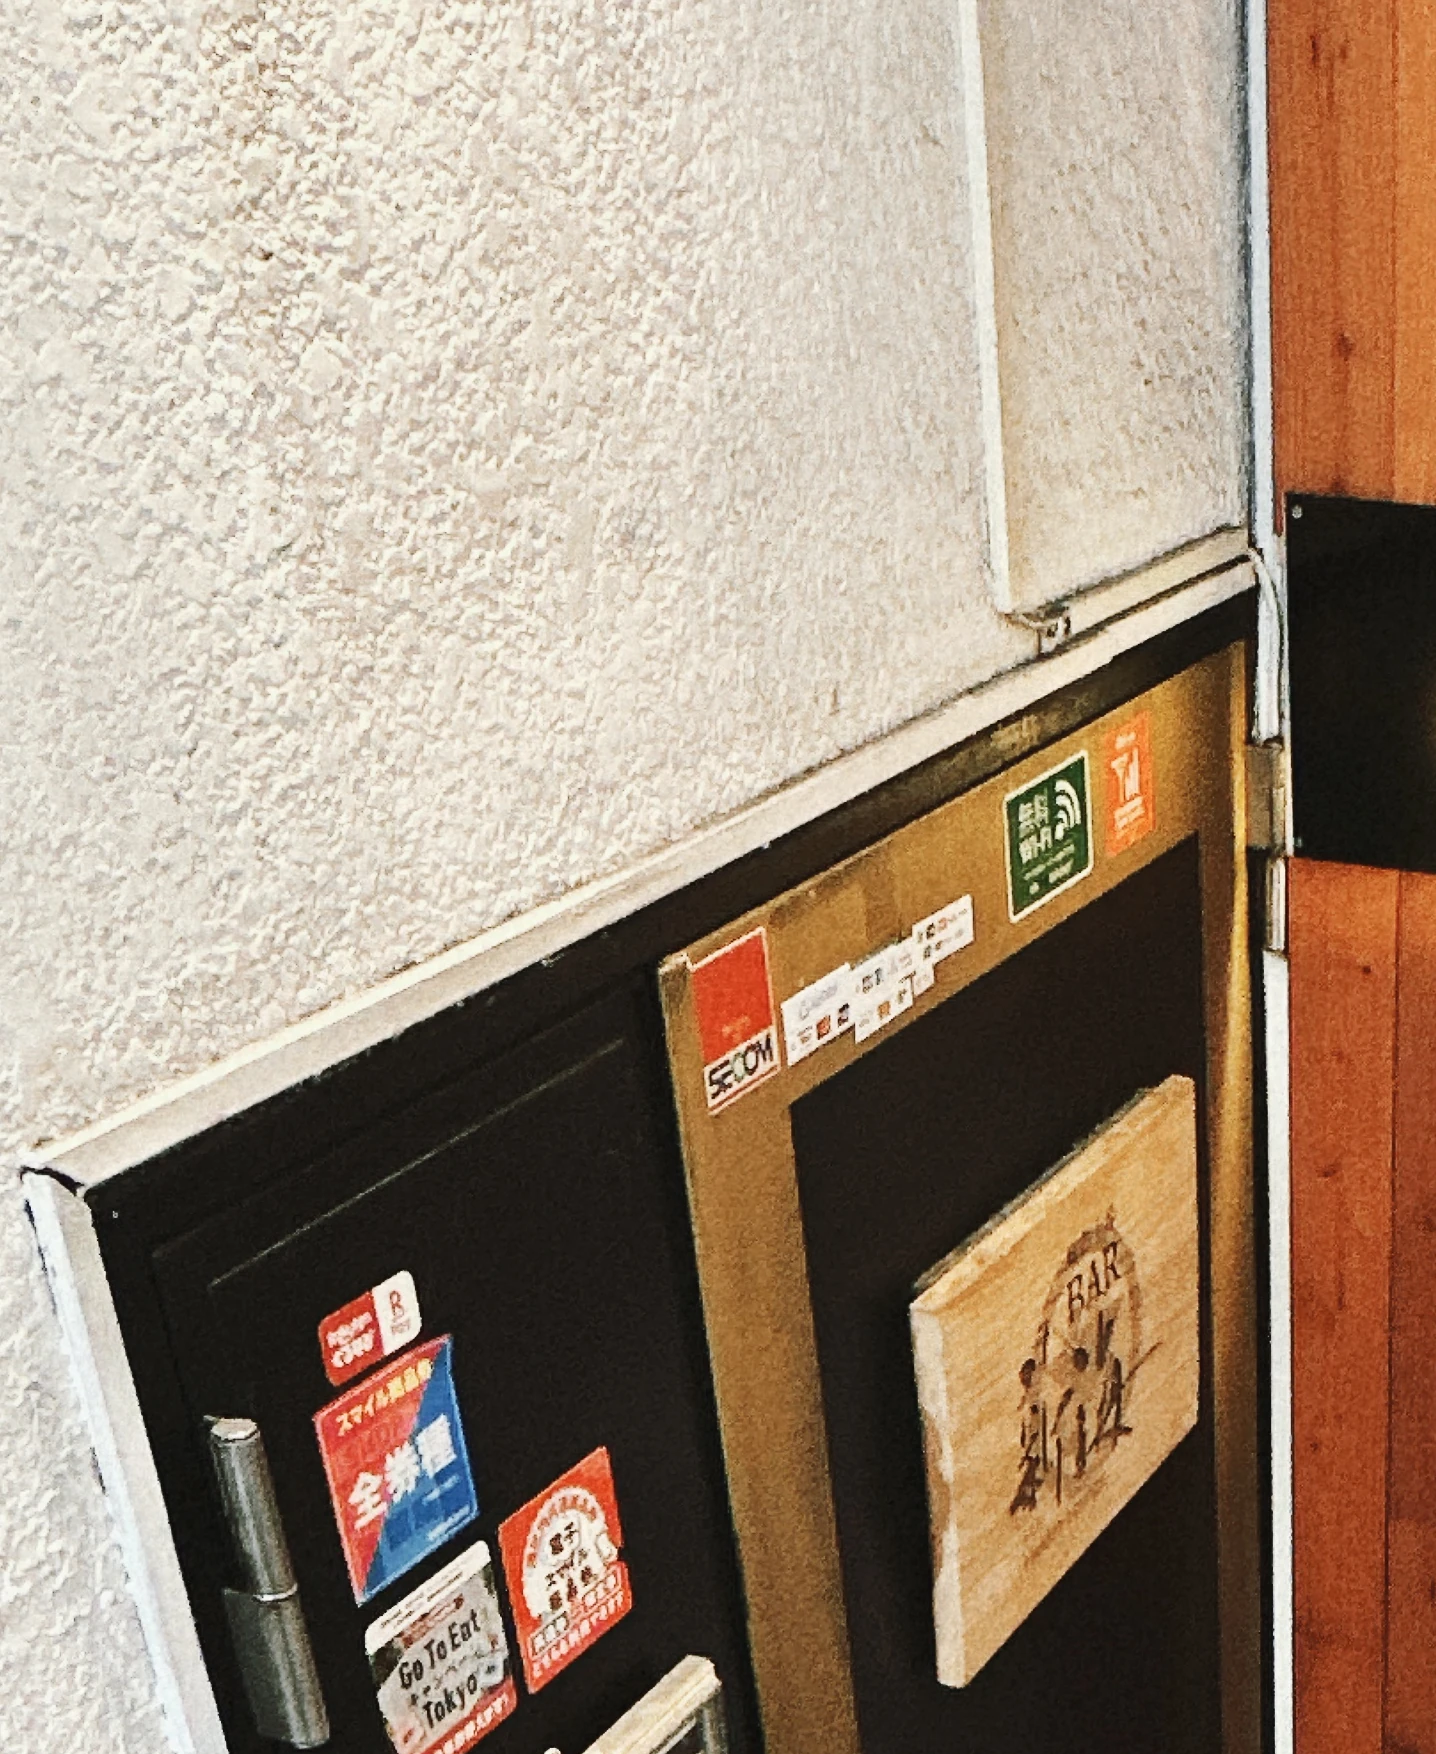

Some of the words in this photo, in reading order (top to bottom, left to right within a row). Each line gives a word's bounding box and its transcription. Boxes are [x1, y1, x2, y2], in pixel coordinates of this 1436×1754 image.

[707, 1032, 774, 1100] SECOM
[1066, 1240, 1122, 1318] BAR
[399, 1656, 425, 1691] Go
[424, 1638, 448, 1667] To
[448, 1609, 482, 1650] Eat
[423, 1675, 479, 1729] Tokyo
